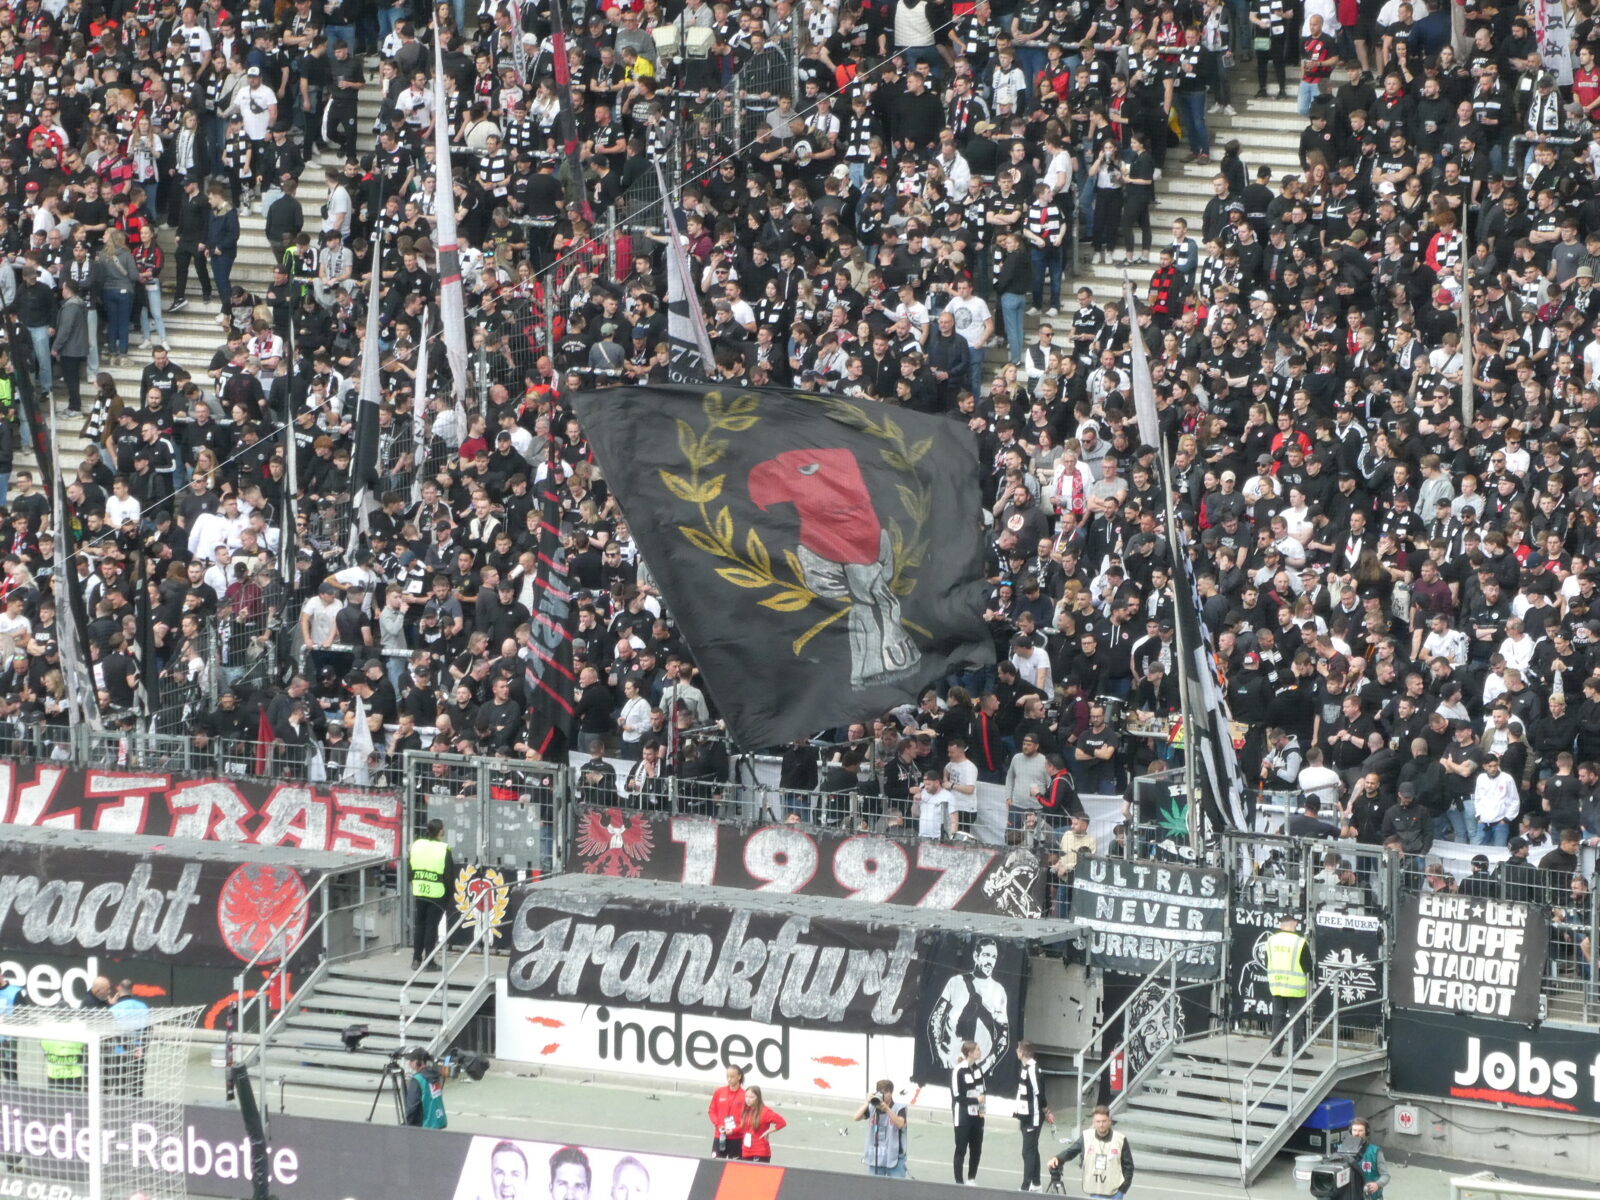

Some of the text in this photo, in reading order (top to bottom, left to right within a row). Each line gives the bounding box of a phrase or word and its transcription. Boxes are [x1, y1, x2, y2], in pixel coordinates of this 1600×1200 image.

[669, 816, 998, 911] 1997
[1089, 860, 1216, 897] ULTRAS
[1095, 895, 1204, 930] NEVER
[1235, 907, 1303, 931] EXTRE
[1318, 915, 1378, 930] FREE MURAT
[1418, 896, 1528, 927] EHRE DER
[1417, 918, 1525, 960] GRUPPE
[509, 890, 918, 1026] Frankfurt
[1413, 950, 1520, 987] STADION
[1413, 977, 1516, 1017] VERBOT
[597, 1004, 790, 1081] indeed
[1454, 1036, 1578, 1100] Jobs
[0, 1178, 72, 1200] LG OLED
[1093, 1173, 1107, 1184] TV
